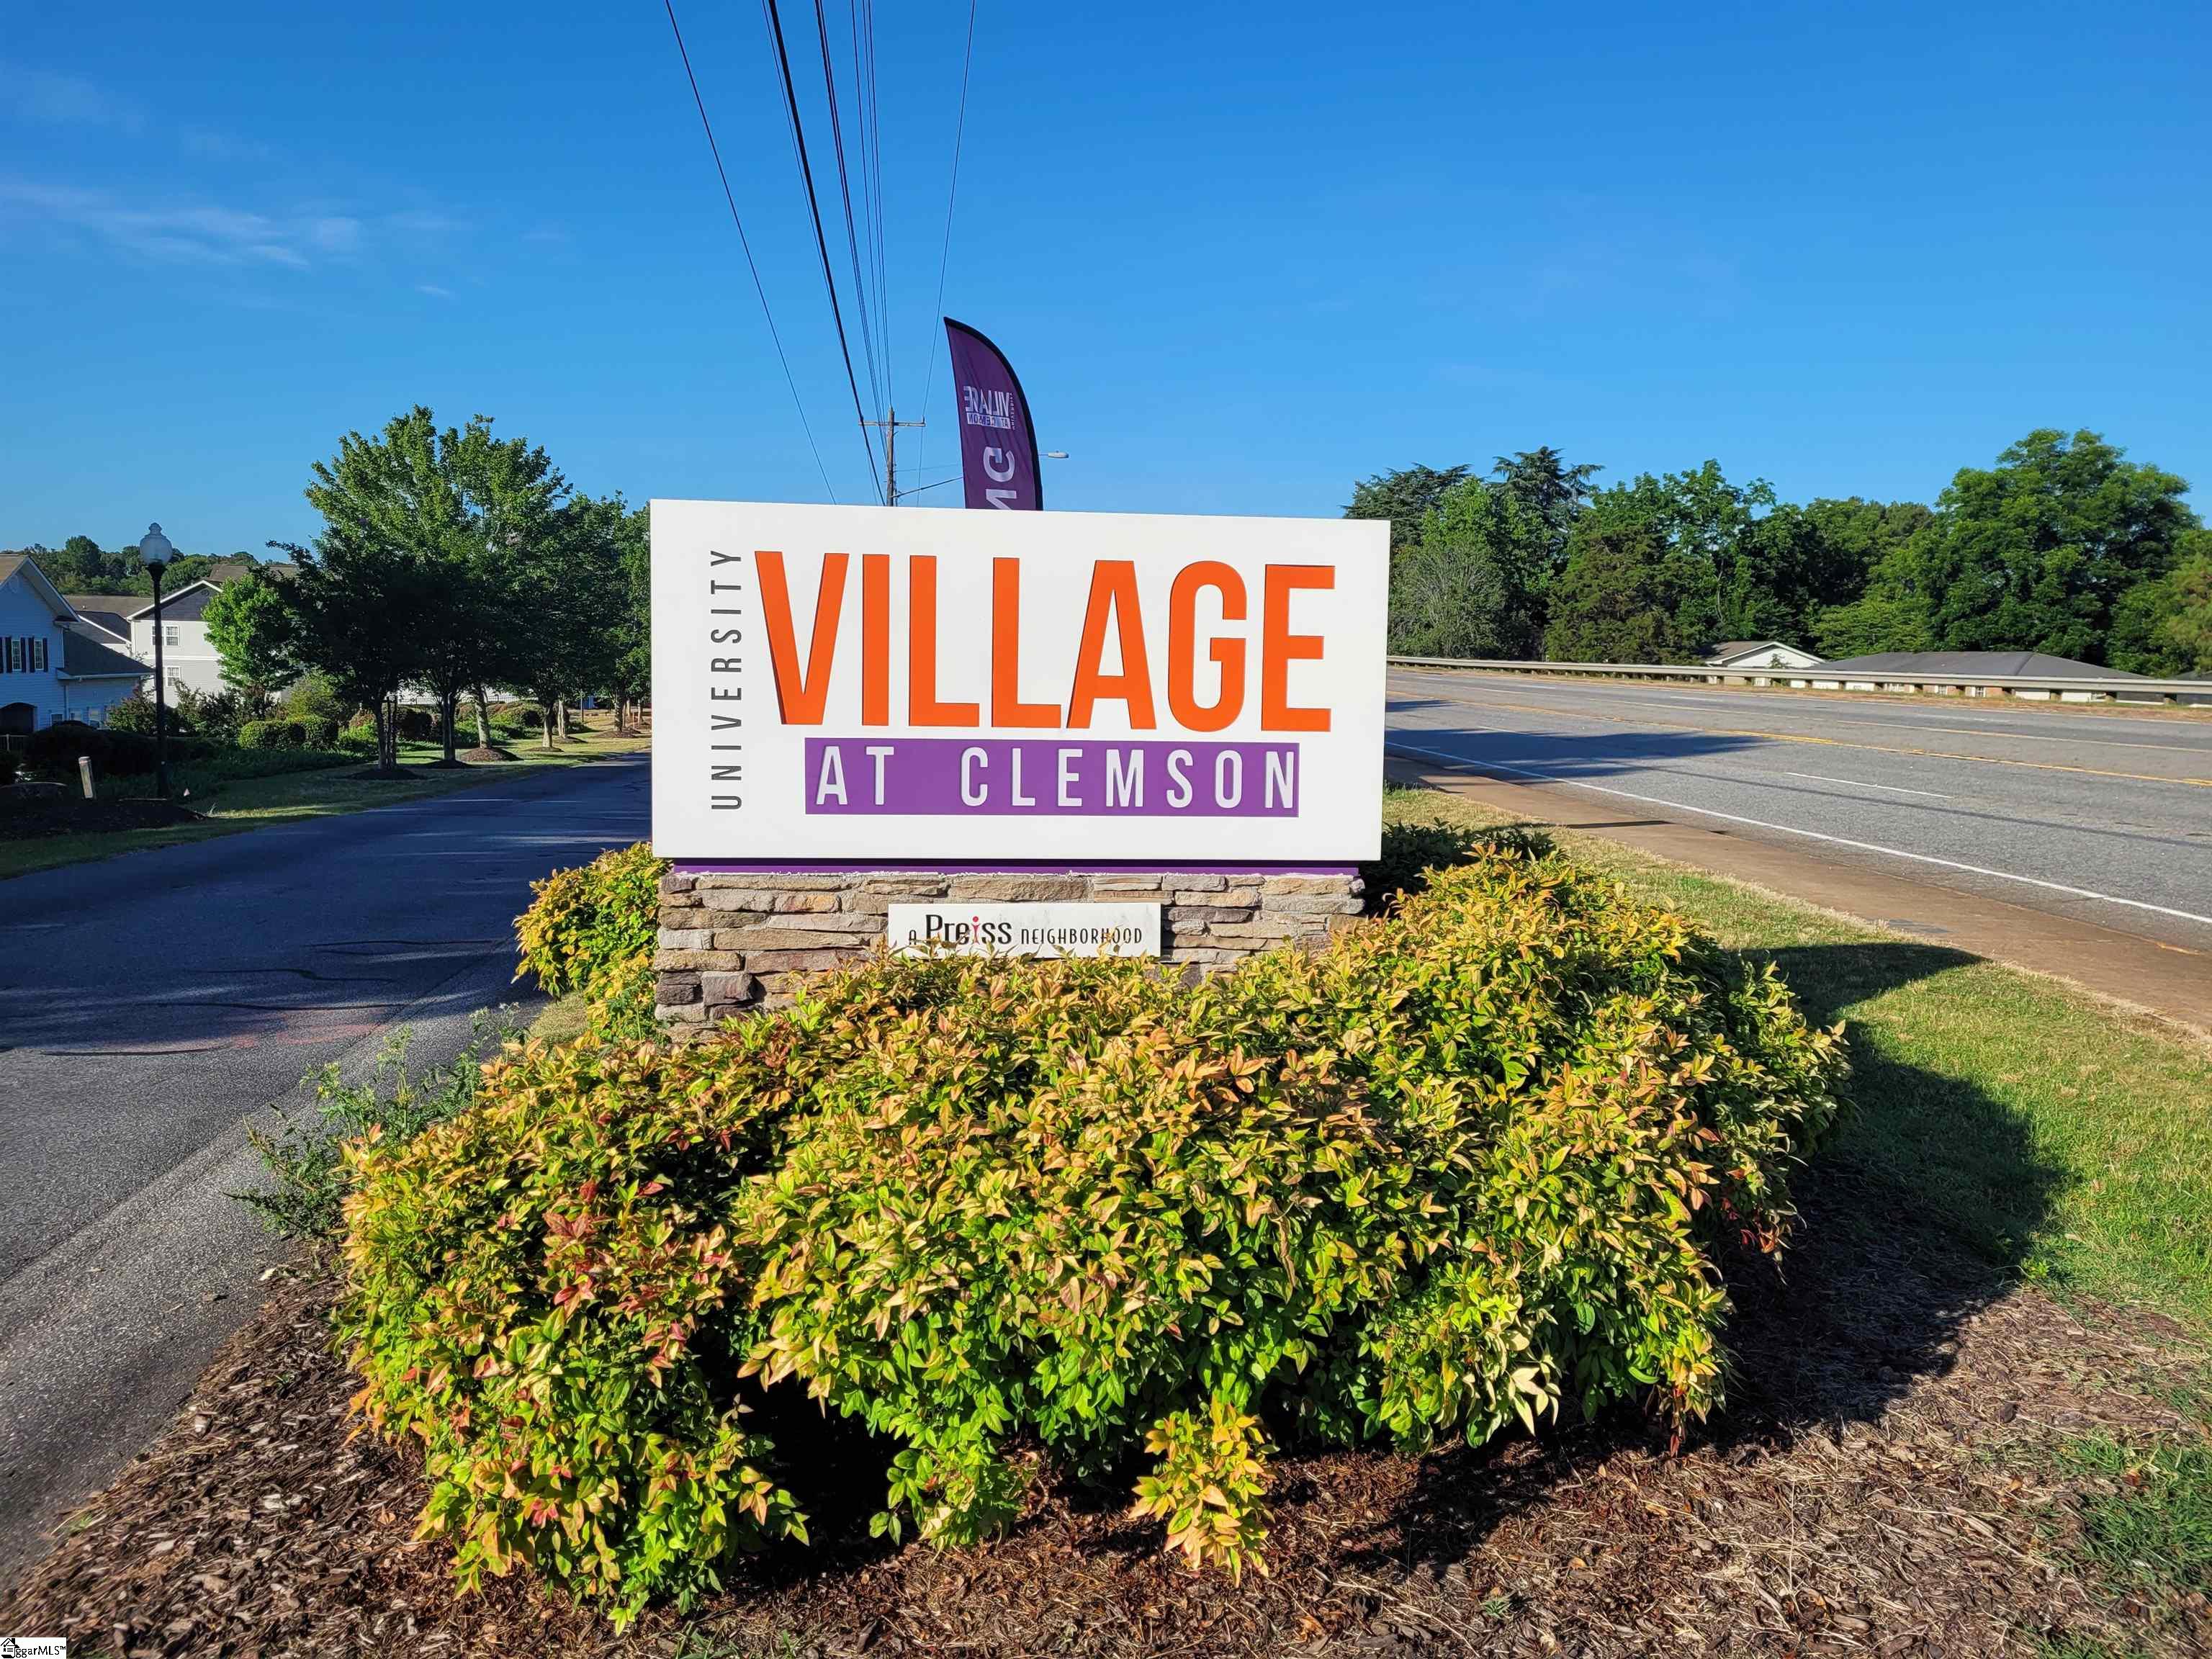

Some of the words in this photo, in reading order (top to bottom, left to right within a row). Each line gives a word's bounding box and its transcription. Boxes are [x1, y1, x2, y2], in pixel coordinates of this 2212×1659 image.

[711, 551, 742, 809] UNIVERSITY
[755, 551, 1336, 732] VILLAGE
[817, 746, 894, 805] AT
[961, 747, 1295, 809] CLEMSON
[925, 914, 1012, 945] Preiss
[1021, 928, 1142, 945] NEIGHBORHOOD
